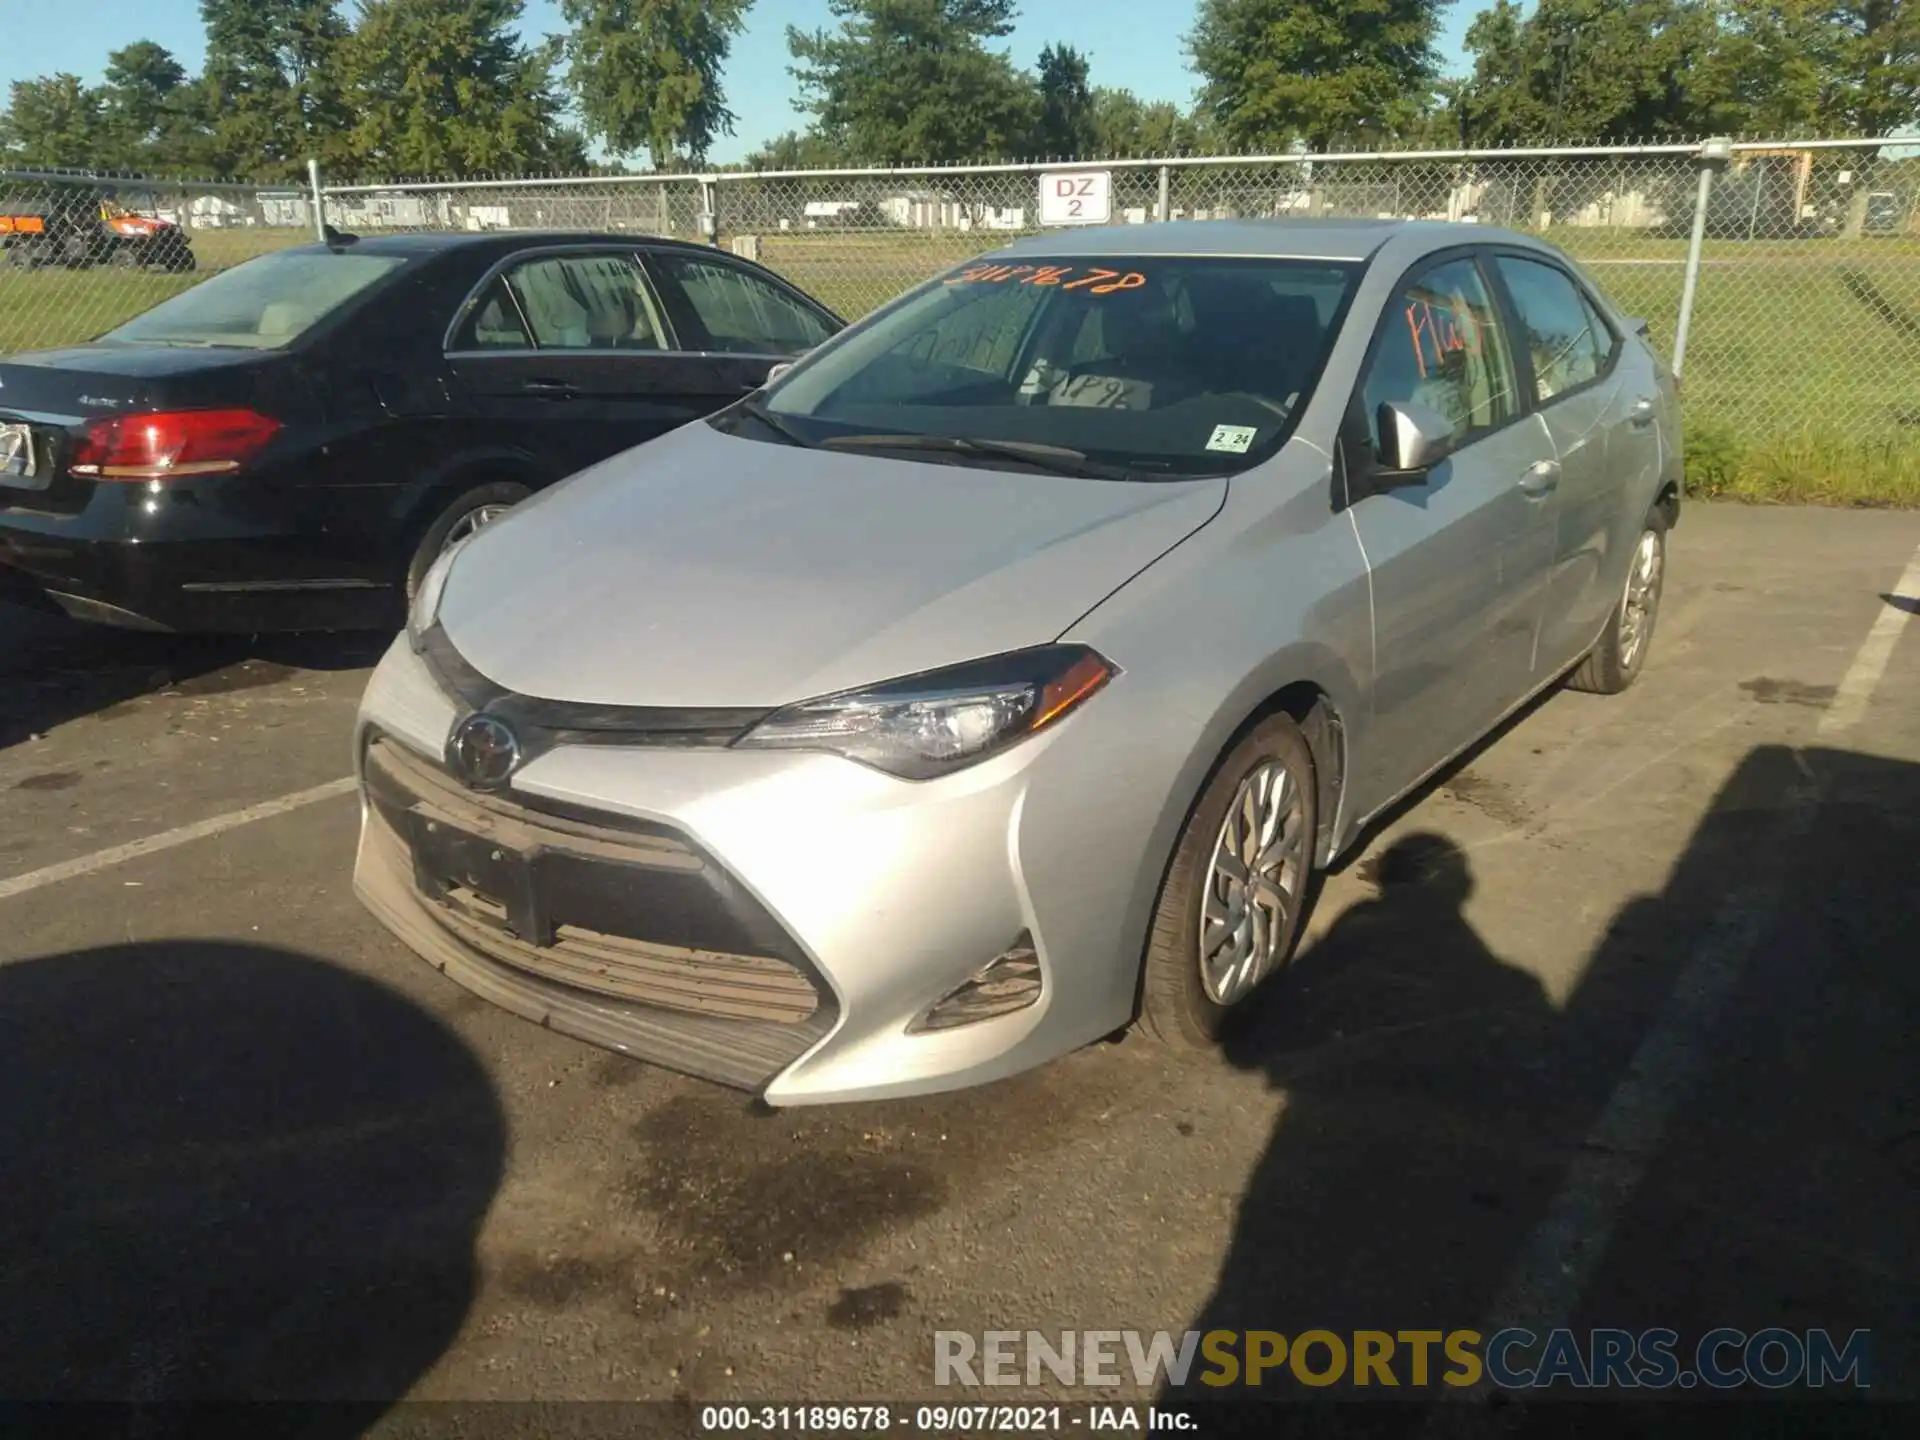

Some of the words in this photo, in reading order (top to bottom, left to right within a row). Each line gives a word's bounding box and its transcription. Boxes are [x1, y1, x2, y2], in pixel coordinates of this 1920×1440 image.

[1056, 178, 1095, 197] DZ
[1067, 199, 1083, 217] 2
[1214, 432, 1226, 443] 2
[1233, 433, 1249, 445] 24
